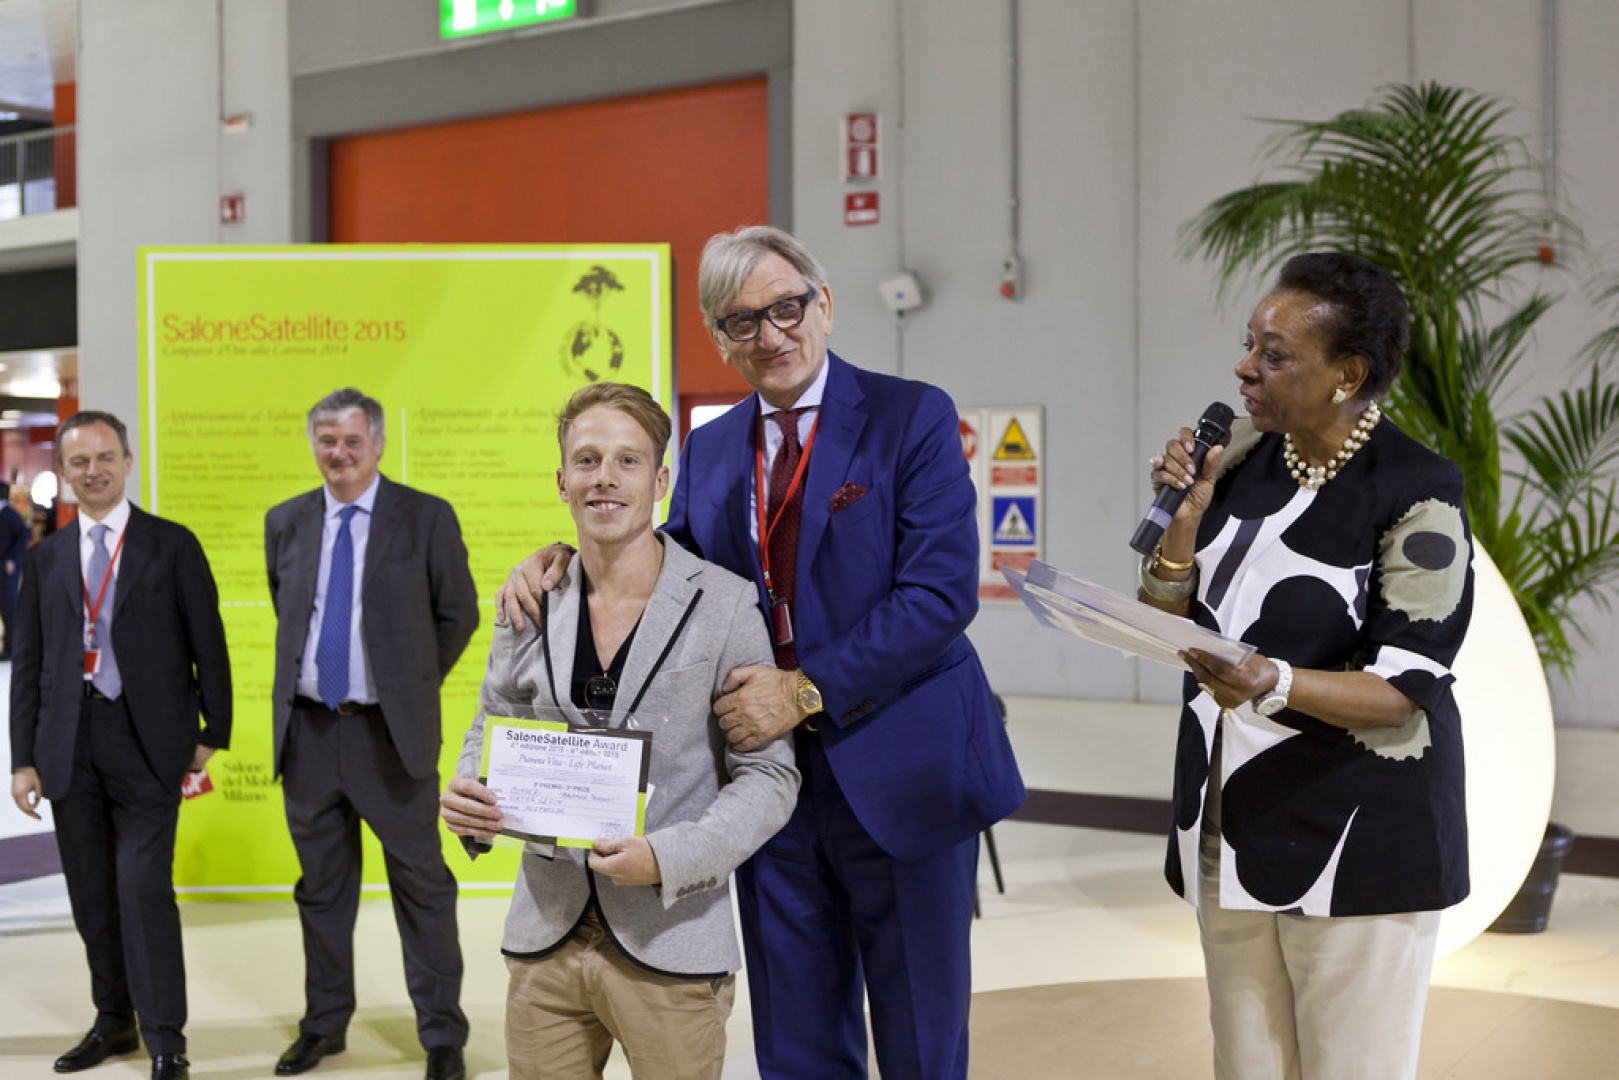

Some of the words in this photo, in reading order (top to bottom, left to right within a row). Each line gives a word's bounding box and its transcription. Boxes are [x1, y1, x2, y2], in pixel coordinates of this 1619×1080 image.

[163, 312, 349, 343] SaloneSatellite
[353, 320, 406, 343] 2015
[506, 730, 591, 748] SaloneSatellite
[592, 738, 629, 751] Award
